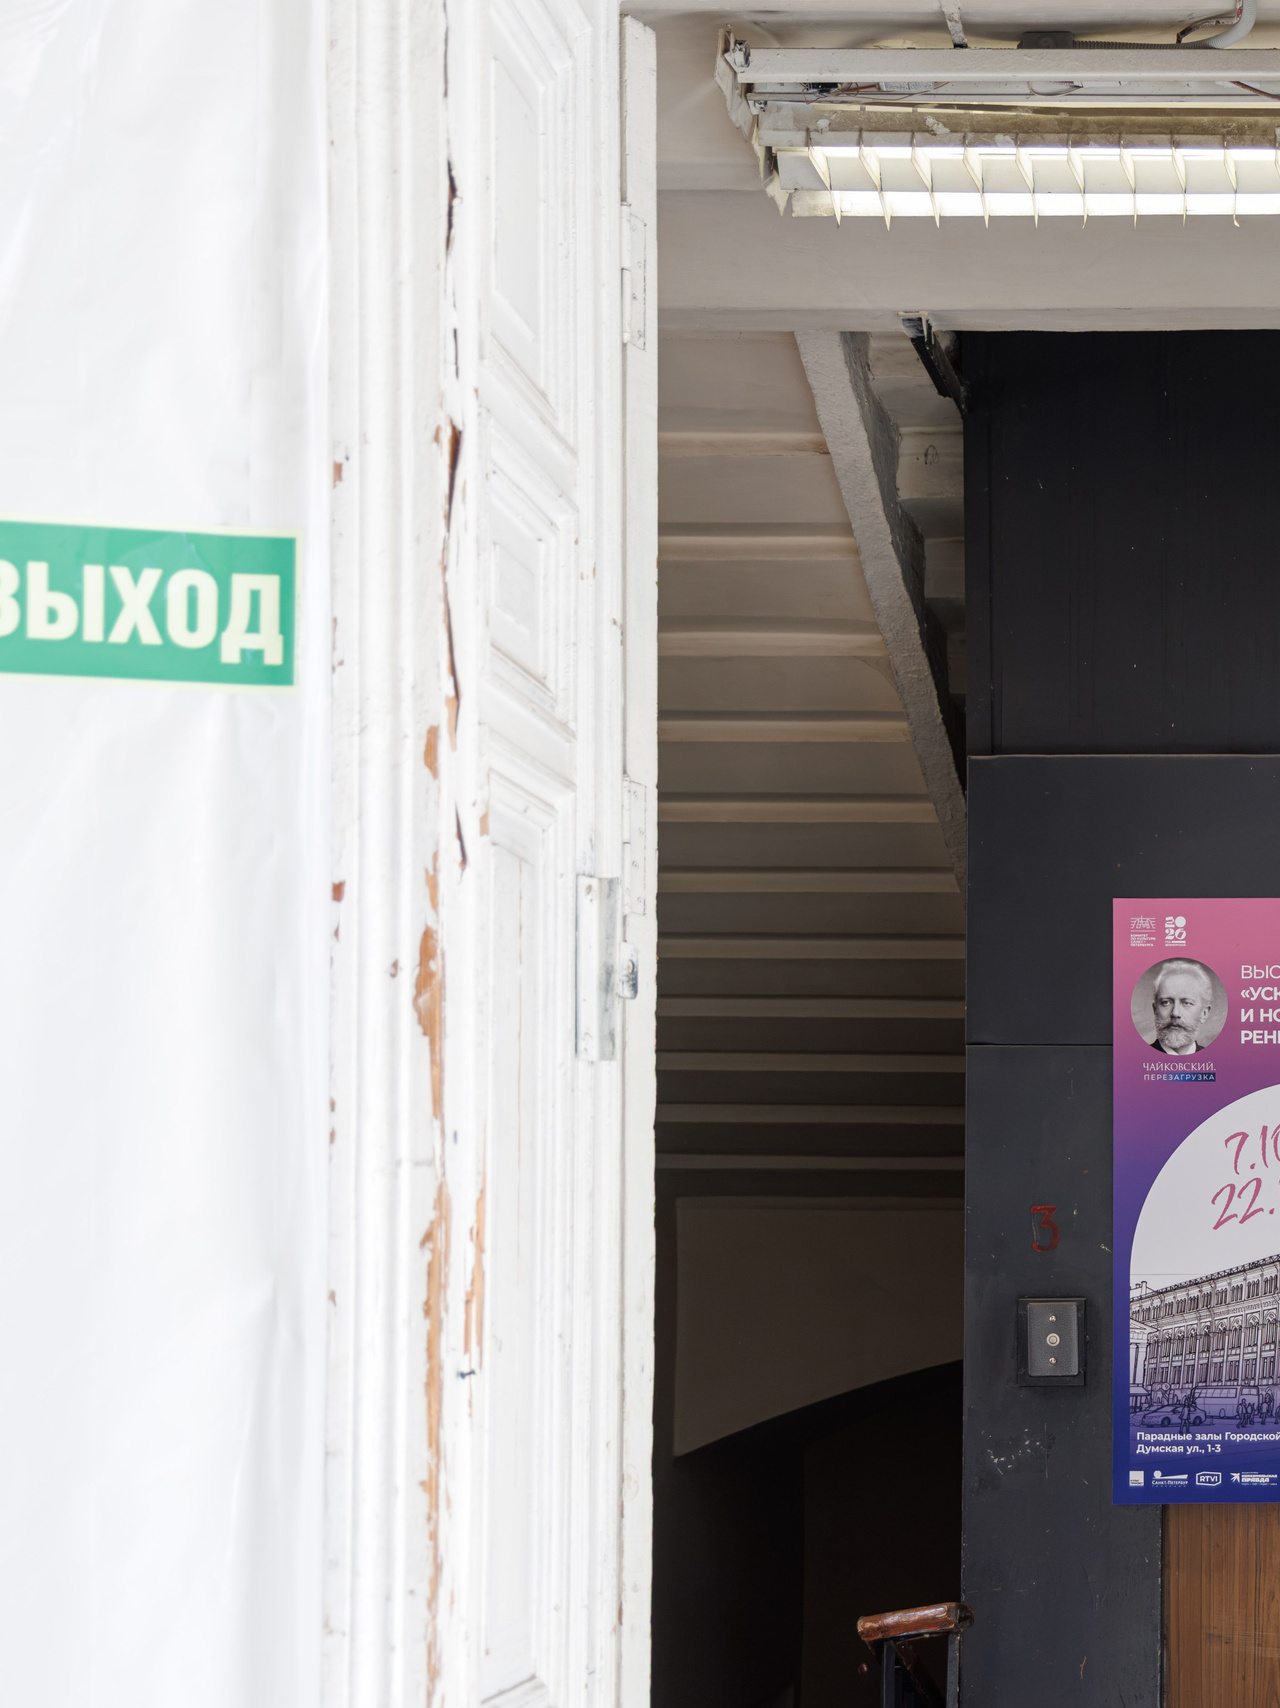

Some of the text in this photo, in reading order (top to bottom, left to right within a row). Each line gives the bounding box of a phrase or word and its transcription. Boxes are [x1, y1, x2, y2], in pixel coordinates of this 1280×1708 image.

[1240, 1008, 1254, 1022] И
[1142, 1061, 1217, 1071] ЧАЙКОВСКИЙ.
[1030, 1205, 1060, 1252] 3
[1136, 1432, 1193, 1442] Парадные
[1195, 1433, 1222, 1441] залы
[1136, 1444, 1222, 1454] Думская ул., 1-3
